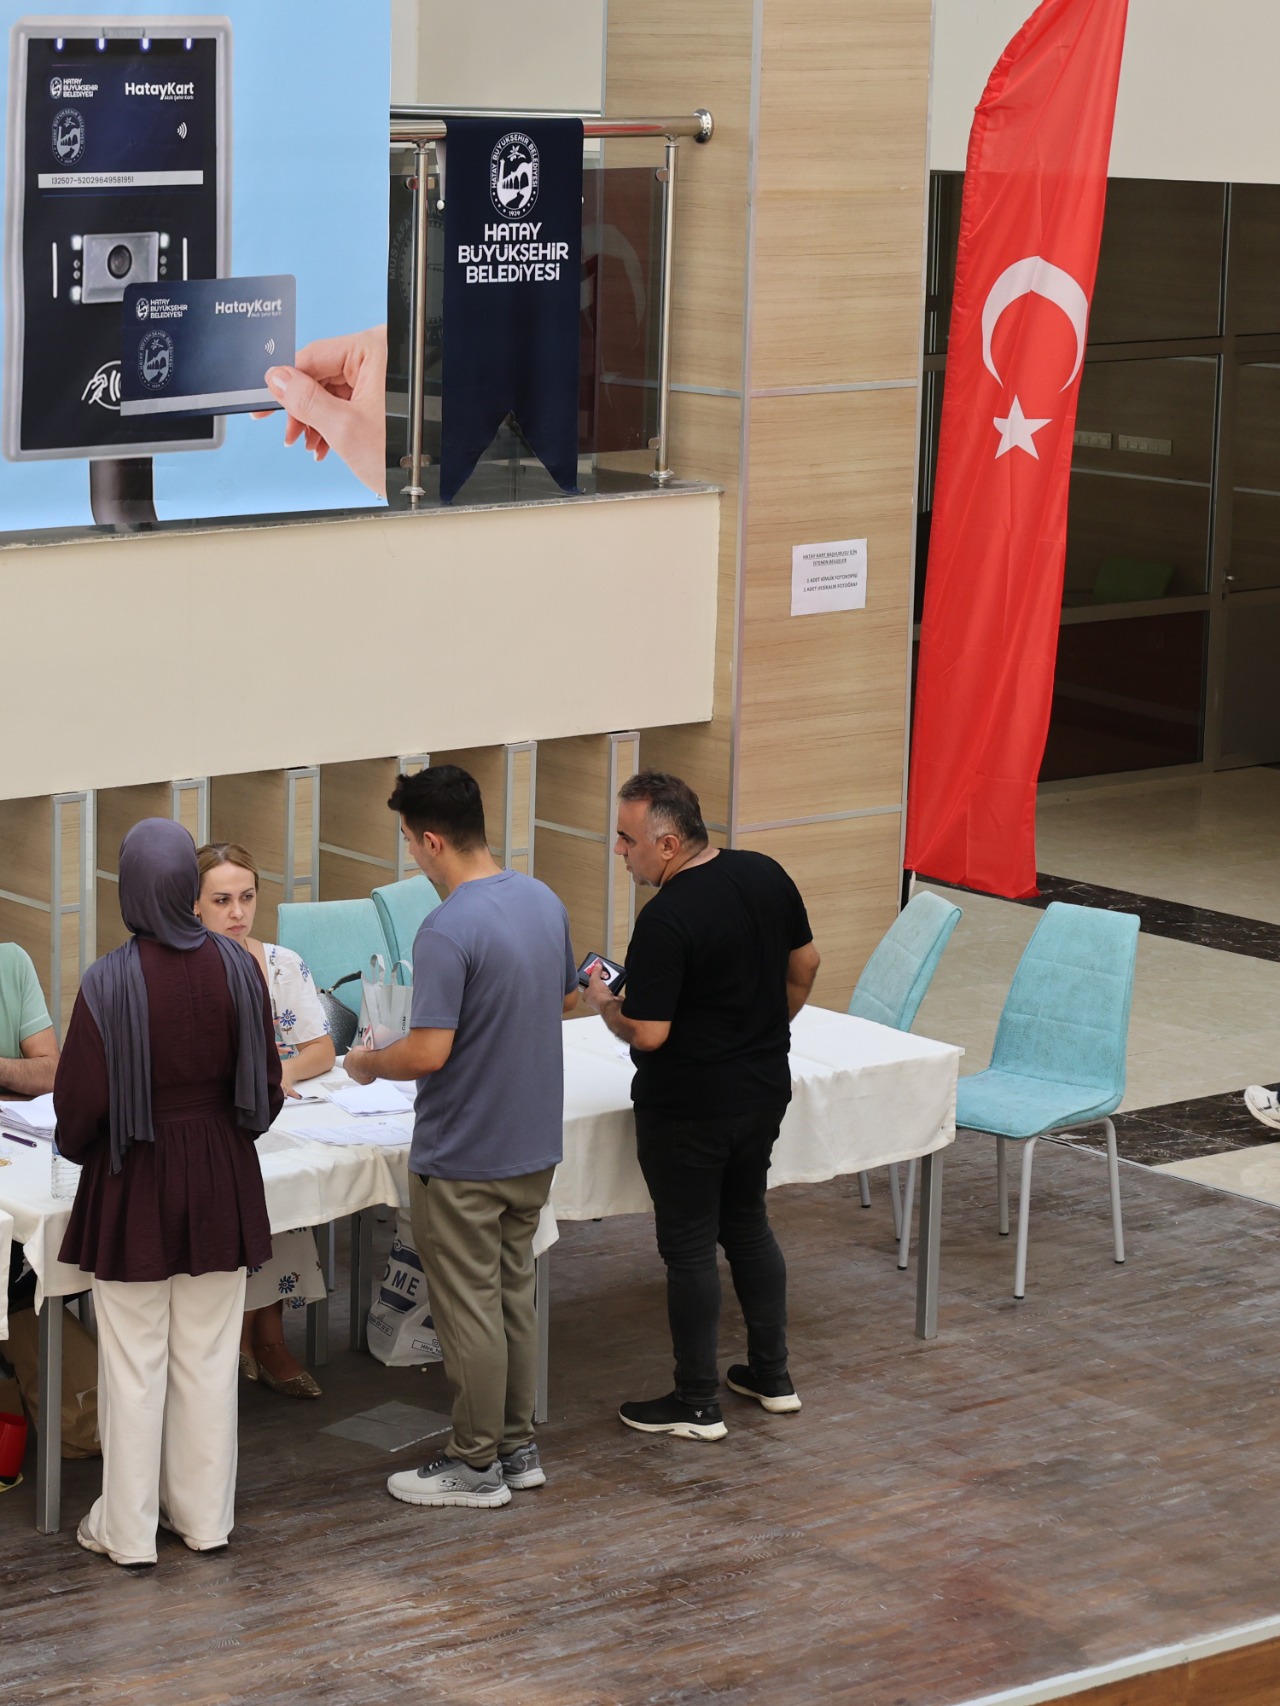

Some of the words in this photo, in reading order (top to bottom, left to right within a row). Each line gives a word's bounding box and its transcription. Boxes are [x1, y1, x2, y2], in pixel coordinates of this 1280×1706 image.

[125, 82, 194, 100] HatayKart
[484, 222, 542, 242] HATAY
[215, 299, 282, 318] HatayKart
